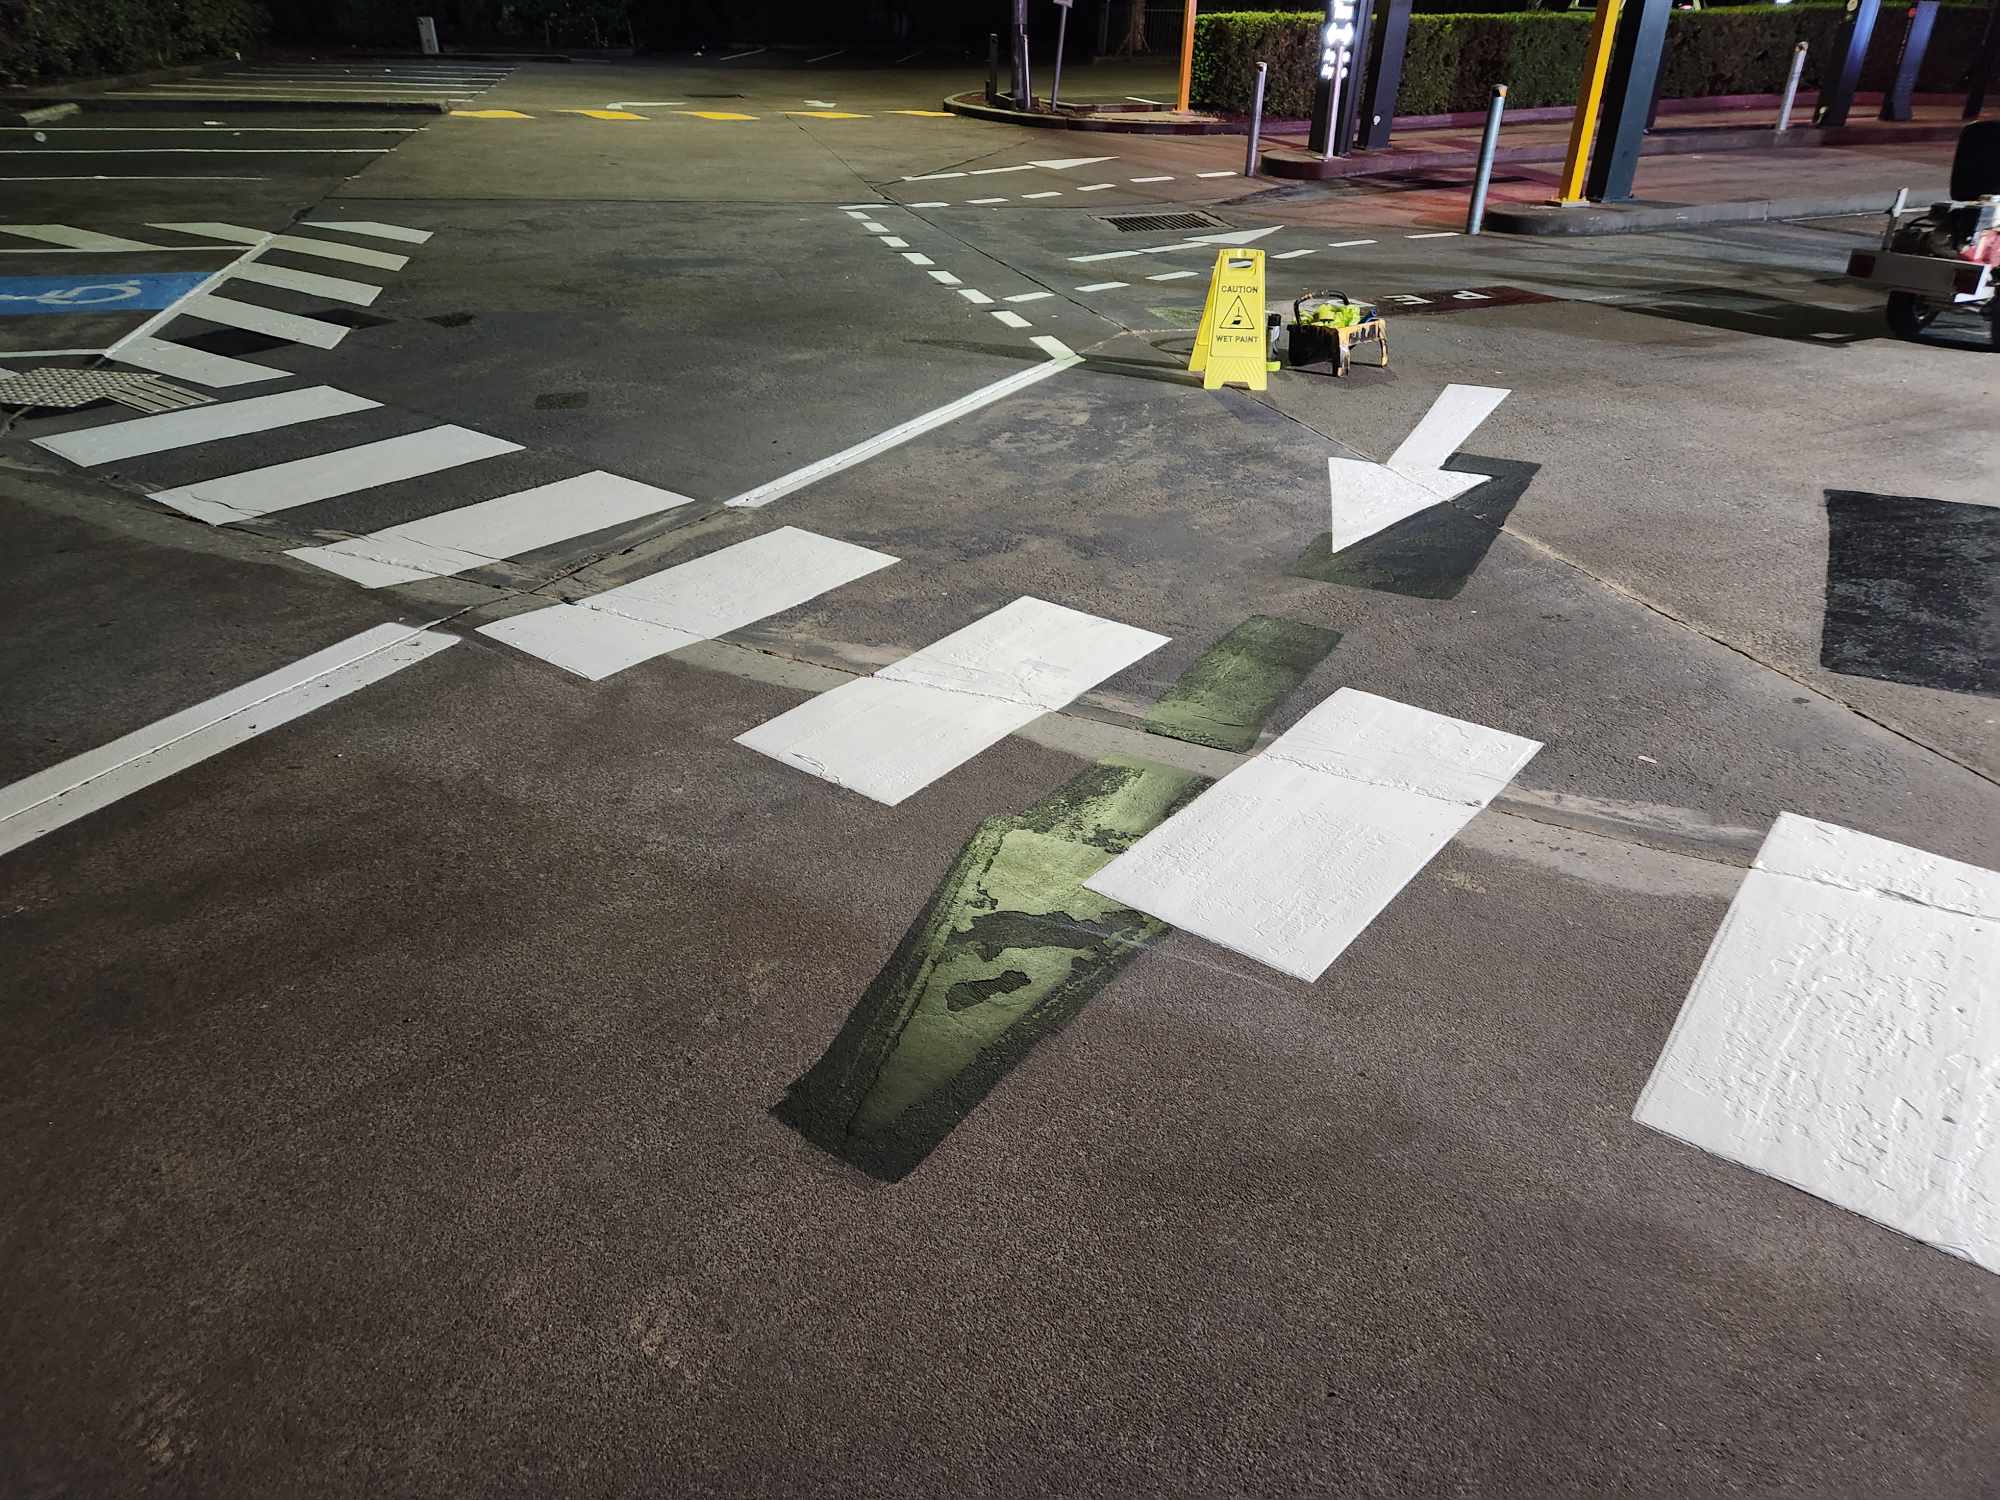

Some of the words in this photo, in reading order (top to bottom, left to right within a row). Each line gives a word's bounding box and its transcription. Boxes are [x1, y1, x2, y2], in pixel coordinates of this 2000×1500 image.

[1221, 285, 1258, 294] CAUTION
[1216, 335, 1234, 343] WET
[1235, 335, 1259, 343] PAINT
